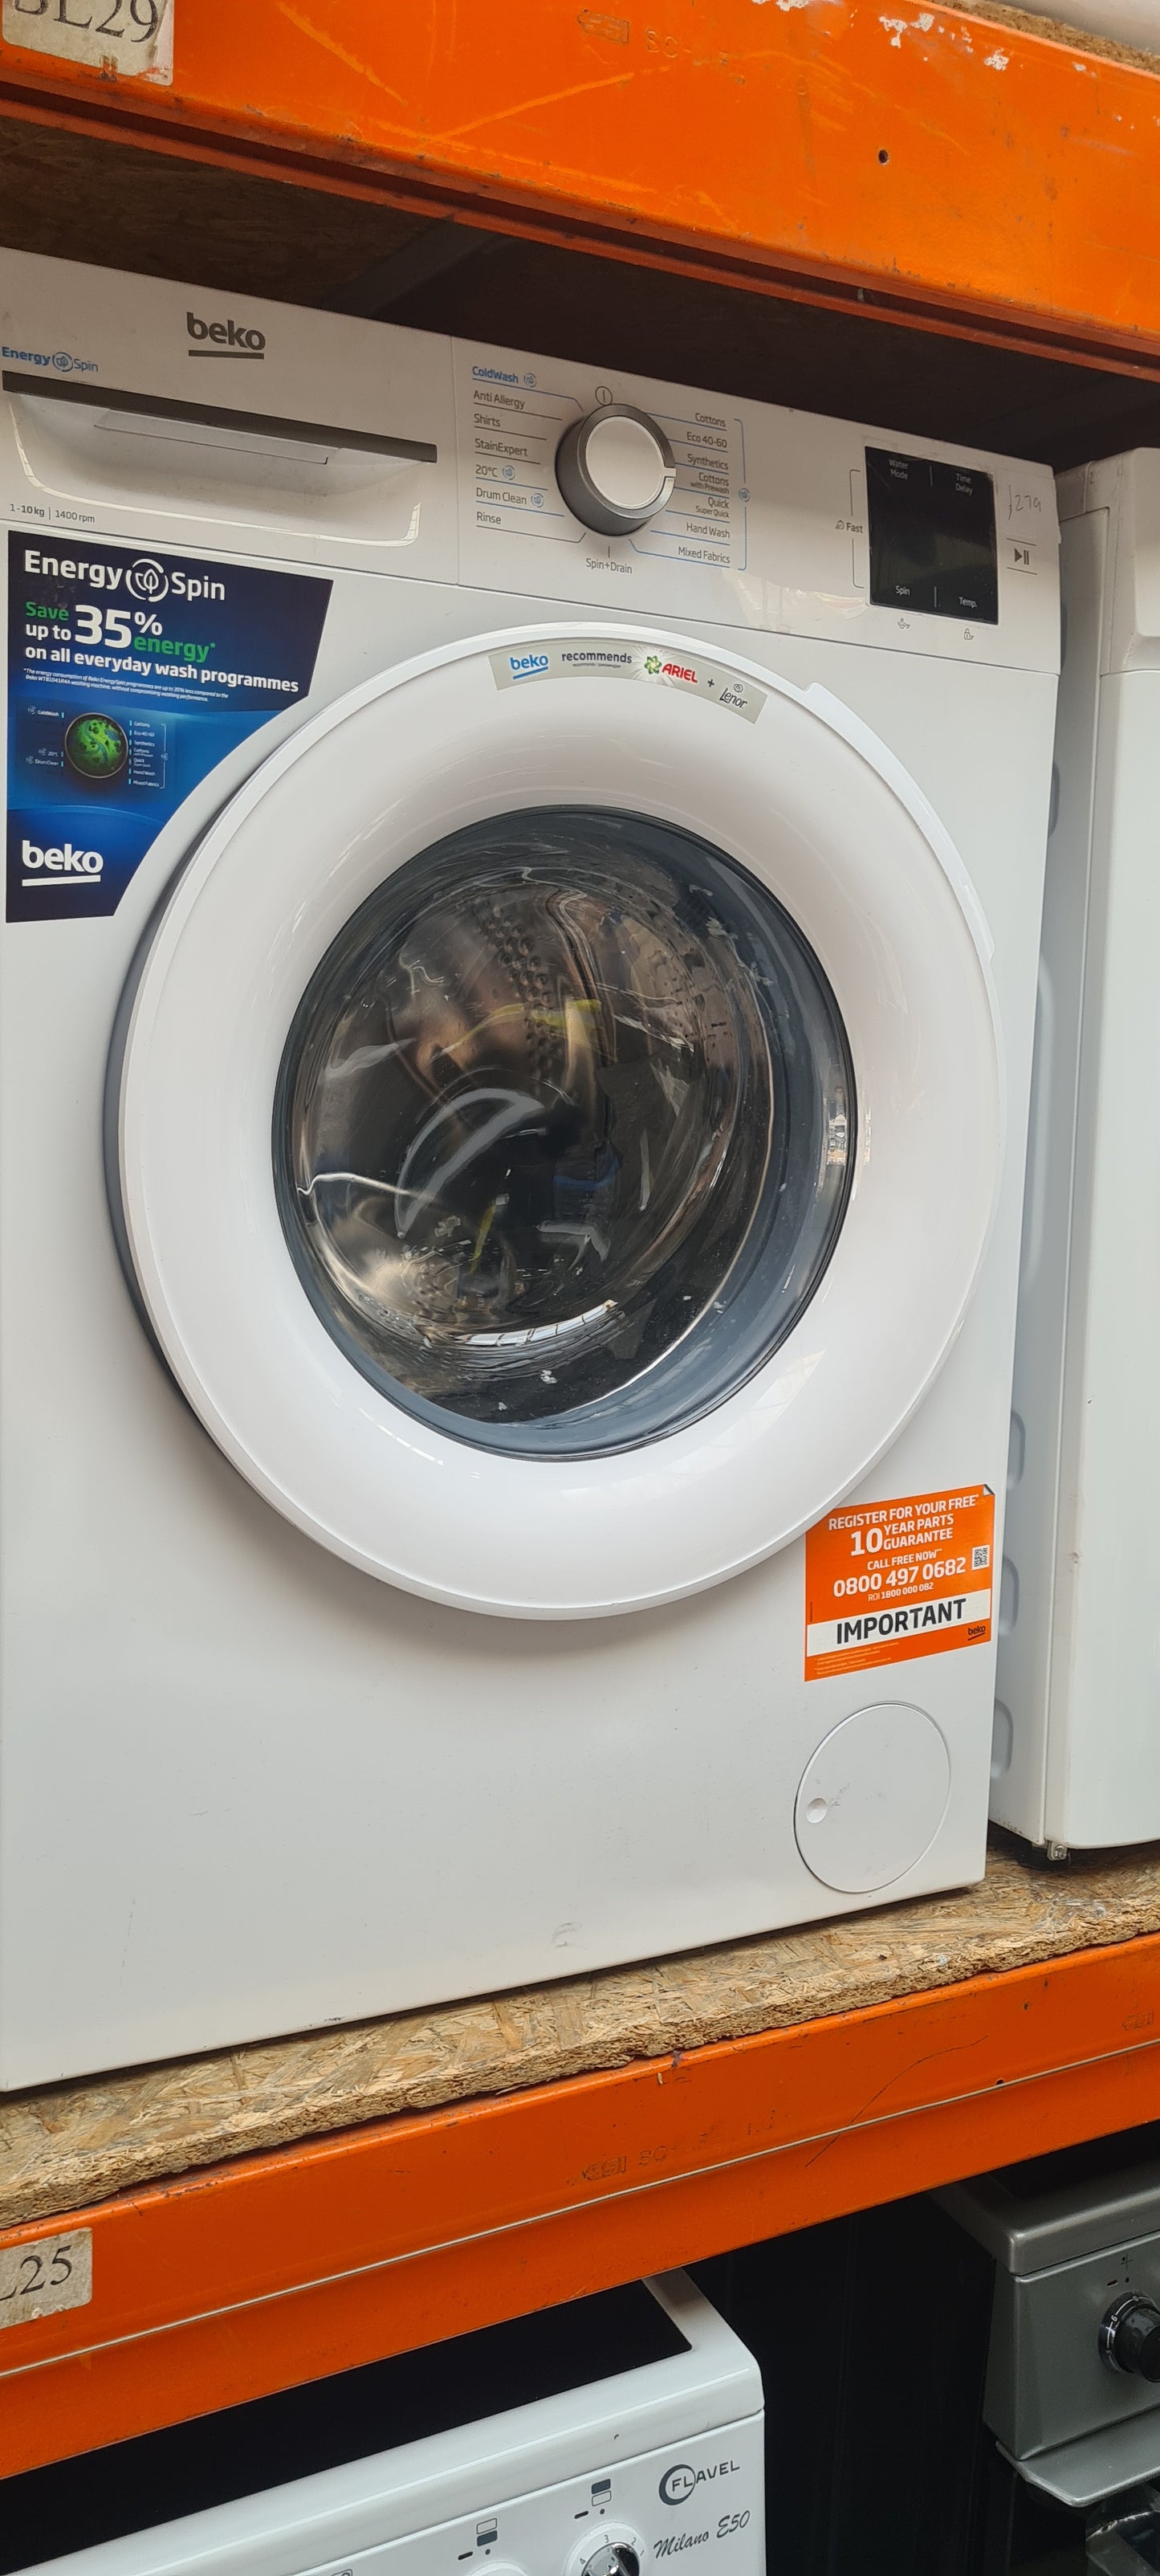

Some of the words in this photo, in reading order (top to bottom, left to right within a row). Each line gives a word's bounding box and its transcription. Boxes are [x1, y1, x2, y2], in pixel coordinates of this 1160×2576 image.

[186, 312, 266, 351] beko
[2, 346, 50, 366] Energy
[74, 358, 98, 372] Spin
[472, 365, 519, 384] ColdWash
[473, 389, 492, 402] Anti
[494, 393, 525, 410] Allergy
[474, 414, 501, 427] Shirts
[695, 412, 726, 427] Cottons
[474, 438, 528, 457] StainExpert
[686, 431, 701, 442] Eco
[702, 435, 727, 448] 40-60
[475, 464, 498, 478] 20°C
[687, 454, 729, 471] Synthetics
[889, 459, 909, 470] Water
[698, 471, 729, 487] Cottons
[890, 469, 909, 480] Mode
[955, 473, 971, 483] Time
[476, 487, 501, 500] Drum
[503, 491, 527, 504] Clean
[690, 481, 704, 489] with
[704, 483, 730, 495] Prewash
[955, 483, 973, 495] Delay
[708, 496, 730, 509] Quick
[34, 506, 45, 518] kg
[55, 509, 78, 520] 1400
[79, 514, 96, 524] rpm
[476, 511, 502, 524] Rinse
[695, 505, 713, 515] Super
[714, 508, 730, 518] Quick
[686, 522, 707, 535] Hand
[709, 526, 731, 539] Wash
[846, 522, 864, 534] Fast
[678, 546, 702, 559] Mixed
[703, 550, 731, 564] Fabrics
[24, 549, 123, 591] Energy
[171, 572, 226, 601] Spin
[895, 585, 910, 597] Spin
[26, 601, 70, 622] Save
[959, 597, 978, 609] Temp.
[26, 622, 51, 642] up
[52, 624, 71, 641] to
[75, 604, 163, 649] 35%
[26, 646, 47, 661] on
[50, 646, 71, 664] all
[74, 654, 151, 677] everyday
[155, 663, 198, 681] wash
[201, 670, 299, 694] programmes
[510, 654, 549, 670] beko
[562, 652, 633, 663] recommends
[661, 662, 698, 683] ARIEL
[719, 687, 748, 708] Lenor
[22, 839, 104, 874] beko
[828, 1510, 887, 1531] REGISTER
[889, 1506, 913, 1521] FOR
[914, 1501, 946, 1516] YOUR
[850, 1527, 883, 1557] 10
[884, 1520, 915, 1536] YEAR
[917, 1514, 954, 1530] PARTS
[883, 1527, 953, 1551] GUARANTEE
[867, 1559, 890, 1571] CALL
[891, 1554, 914, 1566] FREE
[833, 1573, 881, 1597] 0800
[885, 1567, 918, 1587] 497
[922, 1557, 967, 1580] 0682
[868, 1593, 880, 1601] ROI
[881, 1590, 901, 1600] 1800
[902, 1585, 918, 1596] 000
[918, 1582, 934, 1592] 082
[836, 1598, 967, 1645] IMPORTANT
[967, 1625, 986, 1636] beko
[672, 2460, 740, 2492] FLAVEL
[604, 2534, 609, 2543] 3
[631, 2537, 637, 2545] 2
[653, 2530, 709, 2559] Milano
[716, 2510, 750, 2538] E50
